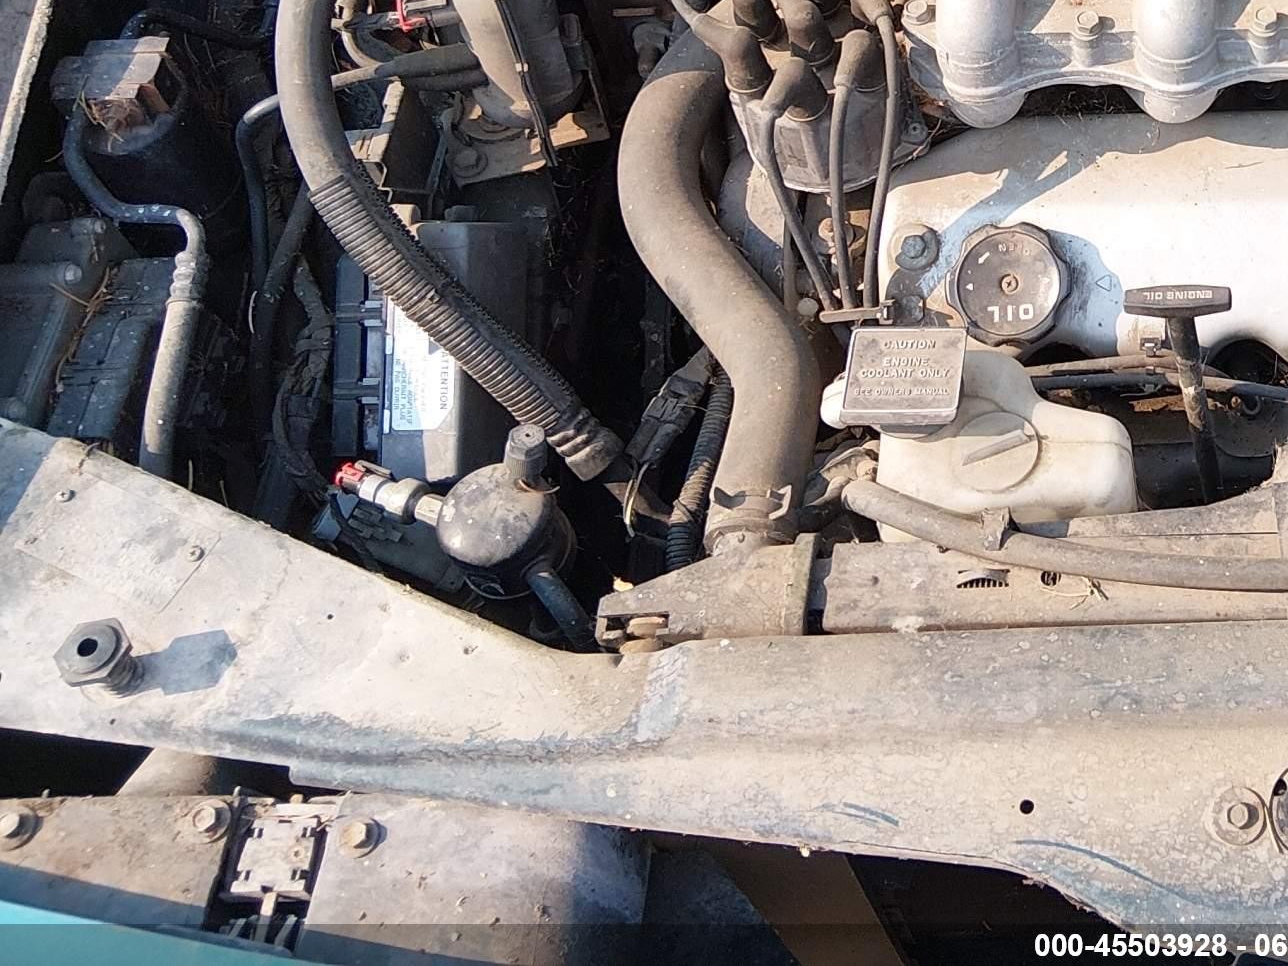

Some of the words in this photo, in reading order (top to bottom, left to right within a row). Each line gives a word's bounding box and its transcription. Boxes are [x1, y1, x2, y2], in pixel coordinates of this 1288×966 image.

[1143, 291, 1163, 301] OIL
[1166, 290, 1213, 300] ENGINE
[987, 303, 1035, 323] OIL
[884, 338, 936, 349] CAUTION
[883, 356, 930, 367] ENGINE
[860, 368, 914, 378] COOLANT
[919, 368, 950, 378] ONLY
[440, 350, 449, 410] ATTENTION
